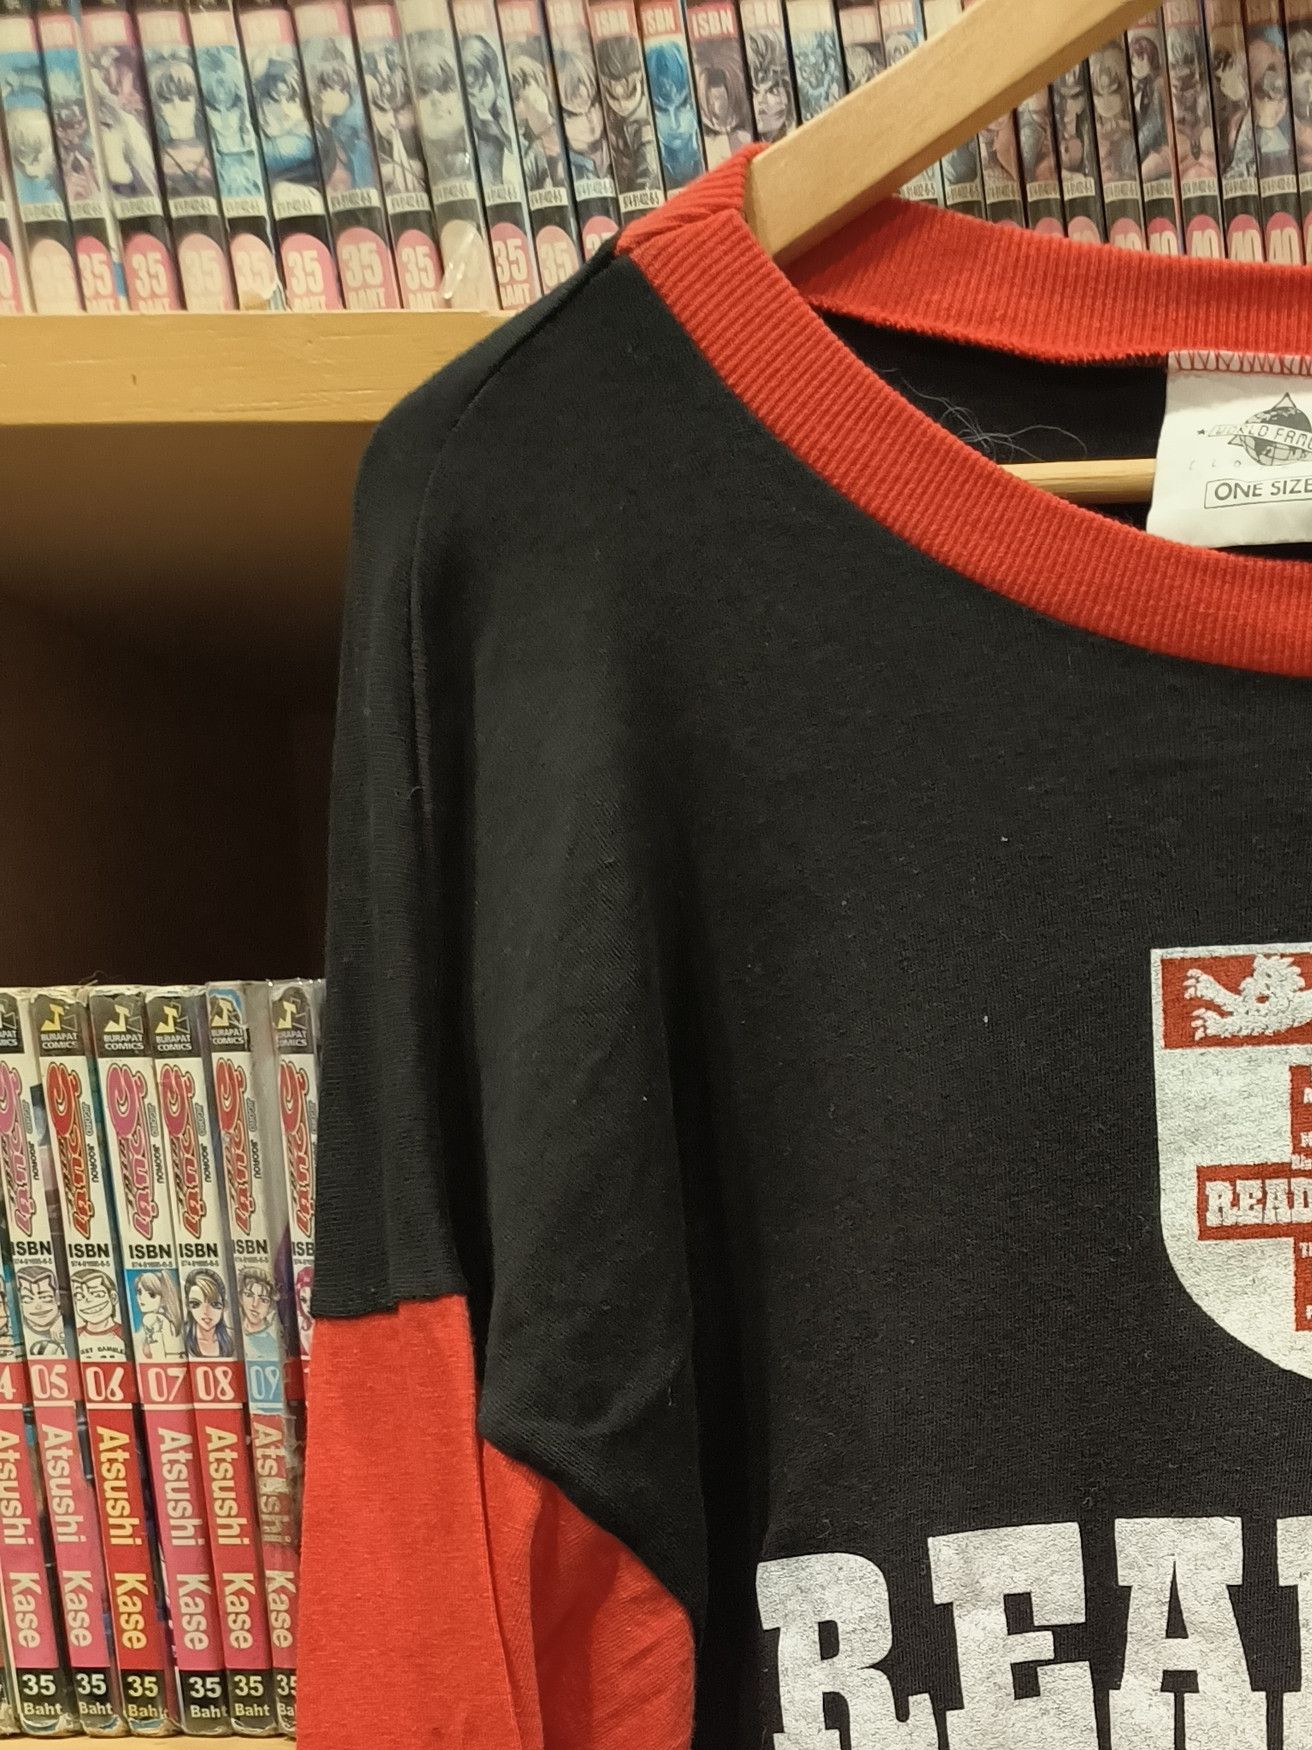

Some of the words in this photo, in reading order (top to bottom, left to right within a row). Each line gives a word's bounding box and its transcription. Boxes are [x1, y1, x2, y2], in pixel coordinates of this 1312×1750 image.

[496, 238, 528, 282] 35
[1268, 226, 1298, 263] 40
[132, 252, 169, 294] 35
[287, 252, 325, 292] 35
[341, 243, 383, 286] 35
[401, 245, 431, 290] 35
[1214, 481, 1262, 500] ONE
[105, 1041, 144, 1051] COMICS
[157, 1042, 192, 1051] COMICS
[68, 1244, 109, 1258] ISBN
[129, 1245, 171, 1259] ISBN
[179, 1244, 218, 1258] ISBN
[232, 1240, 268, 1254] ISBN
[33, 1366, 69, 1398] 05
[86, 1366, 124, 1401] 06
[148, 1366, 187, 1402] 07
[196, 1366, 235, 1401] 08
[249, 1366, 281, 1400] 09
[42, 1424, 87, 1544] Atsushi
[96, 1426, 143, 1546] Atsushi
[157, 1427, 206, 1547] Atsushi
[205, 1426, 250, 1545] Atsushi
[254, 1422, 292, 1544] Atsushi
[8, 1572, 41, 1648] Kase
[62, 1570, 94, 1647] Kase
[115, 1573, 148, 1649] Kase
[176, 1574, 209, 1650] Kase
[222, 1572, 256, 1648] Kase
[265, 1571, 295, 1648] Kase
[22, 1675, 56, 1695] 35
[76, 1674, 107, 1694] 35
[127, 1676, 158, 1697] 35
[189, 1677, 222, 1698] 35
[234, 1675, 263, 1696] 35
[25, 1702, 62, 1716] Baht
[80, 1702, 113, 1715] Baht
[191, 1705, 227, 1718] Baht
[235, 1704, 270, 1717] Baht
